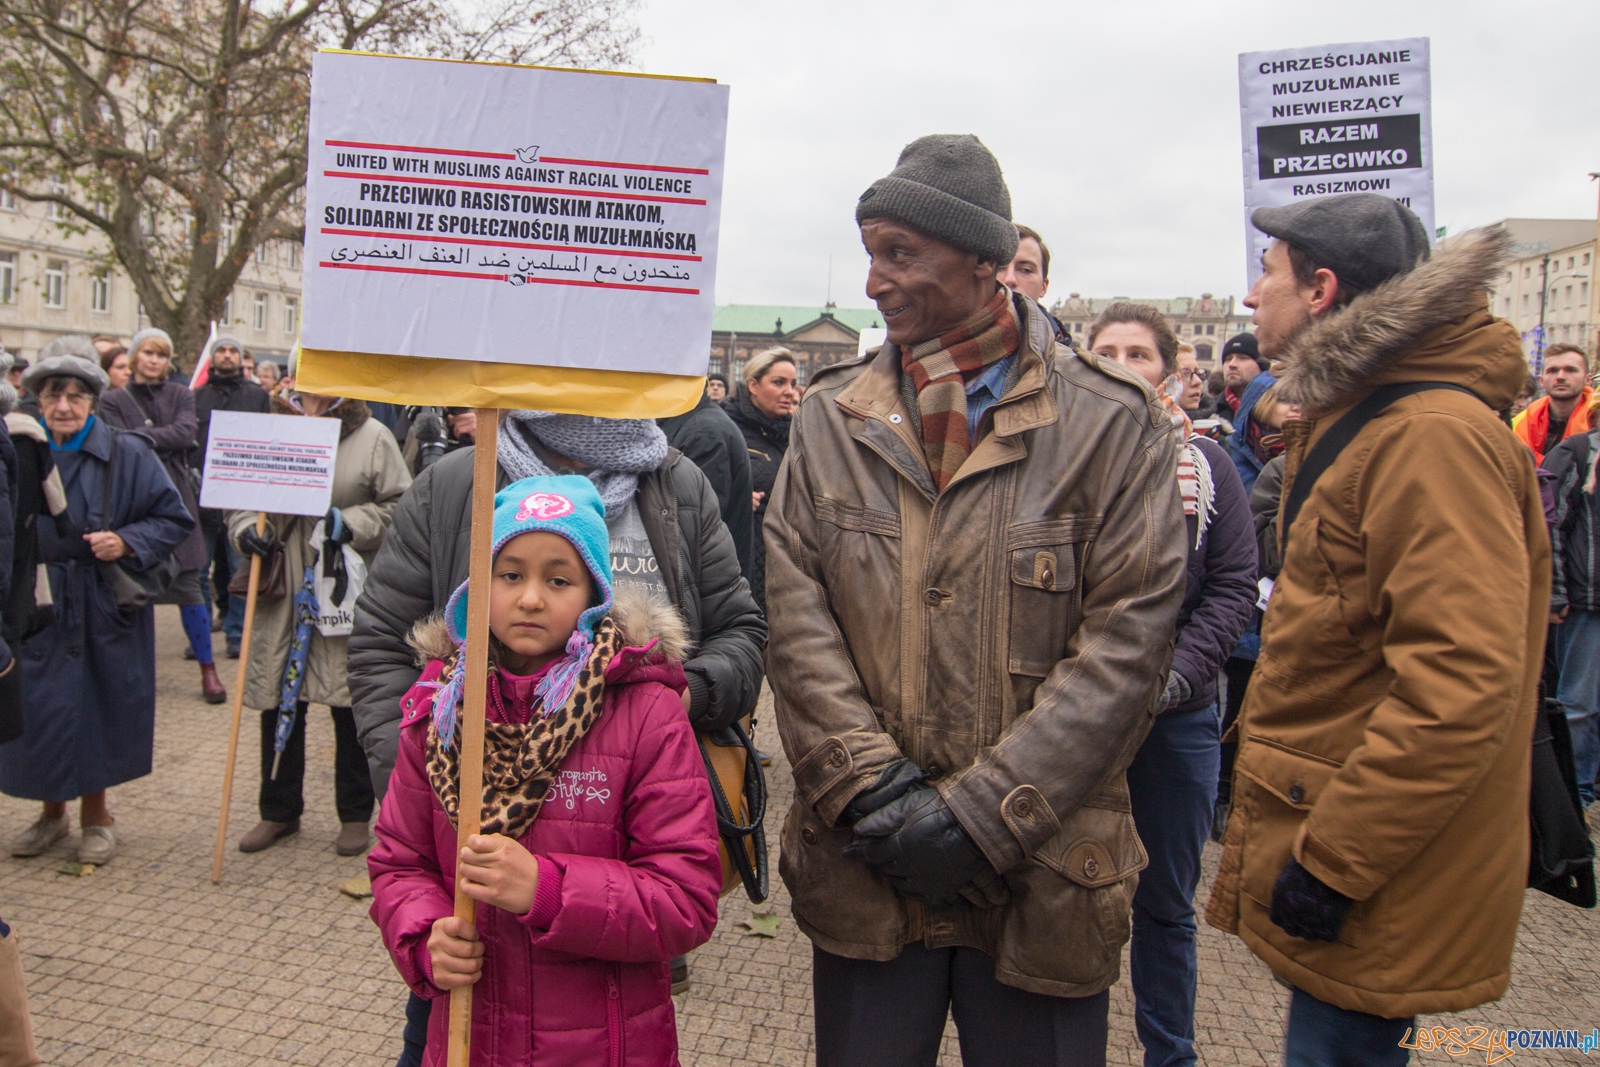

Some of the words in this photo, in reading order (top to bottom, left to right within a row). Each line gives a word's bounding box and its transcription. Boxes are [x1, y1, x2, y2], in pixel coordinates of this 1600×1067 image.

[1258, 49, 1411, 75] CHRZEŚCIJANIE
[1272, 73, 1401, 96] MUZUŁMANIE
[1272, 95, 1404, 118] NIEWIERZĄCY
[1299, 123, 1379, 146] RAZEM
[1273, 148, 1408, 174] PRZECIWKO
[336, 153, 387, 170] UNITED
[392, 157, 429, 173] WITH
[434, 160, 501, 179] MUSLIMS
[504, 166, 565, 184] AGAINST
[568, 171, 619, 188] RACIAL
[624, 175, 692, 194] VIOLENCE
[1293, 178, 1391, 196] RASIZMOWI
[360, 183, 456, 208] PRZECIWKO
[460, 190, 592, 219] RASISTOWSKIM
[595, 201, 665, 225] ATAKOM,
[324, 205, 413, 230] SOLIDARNI
[416, 213, 434, 231] ZE
[438, 214, 570, 245] SPOŁECZNOŚCIĄ
[573, 225, 697, 254] MUZUŁMAŃSKĄ
[330, 243, 413, 267] العنصري
[418, 246, 470, 265] العنف
[478, 252, 511, 268] ضد
[517, 253, 588, 276] المسلمين
[593, 265, 617, 283] مع
[622, 263, 690, 282] متحدون
[561, 766, 607, 783] romantic
